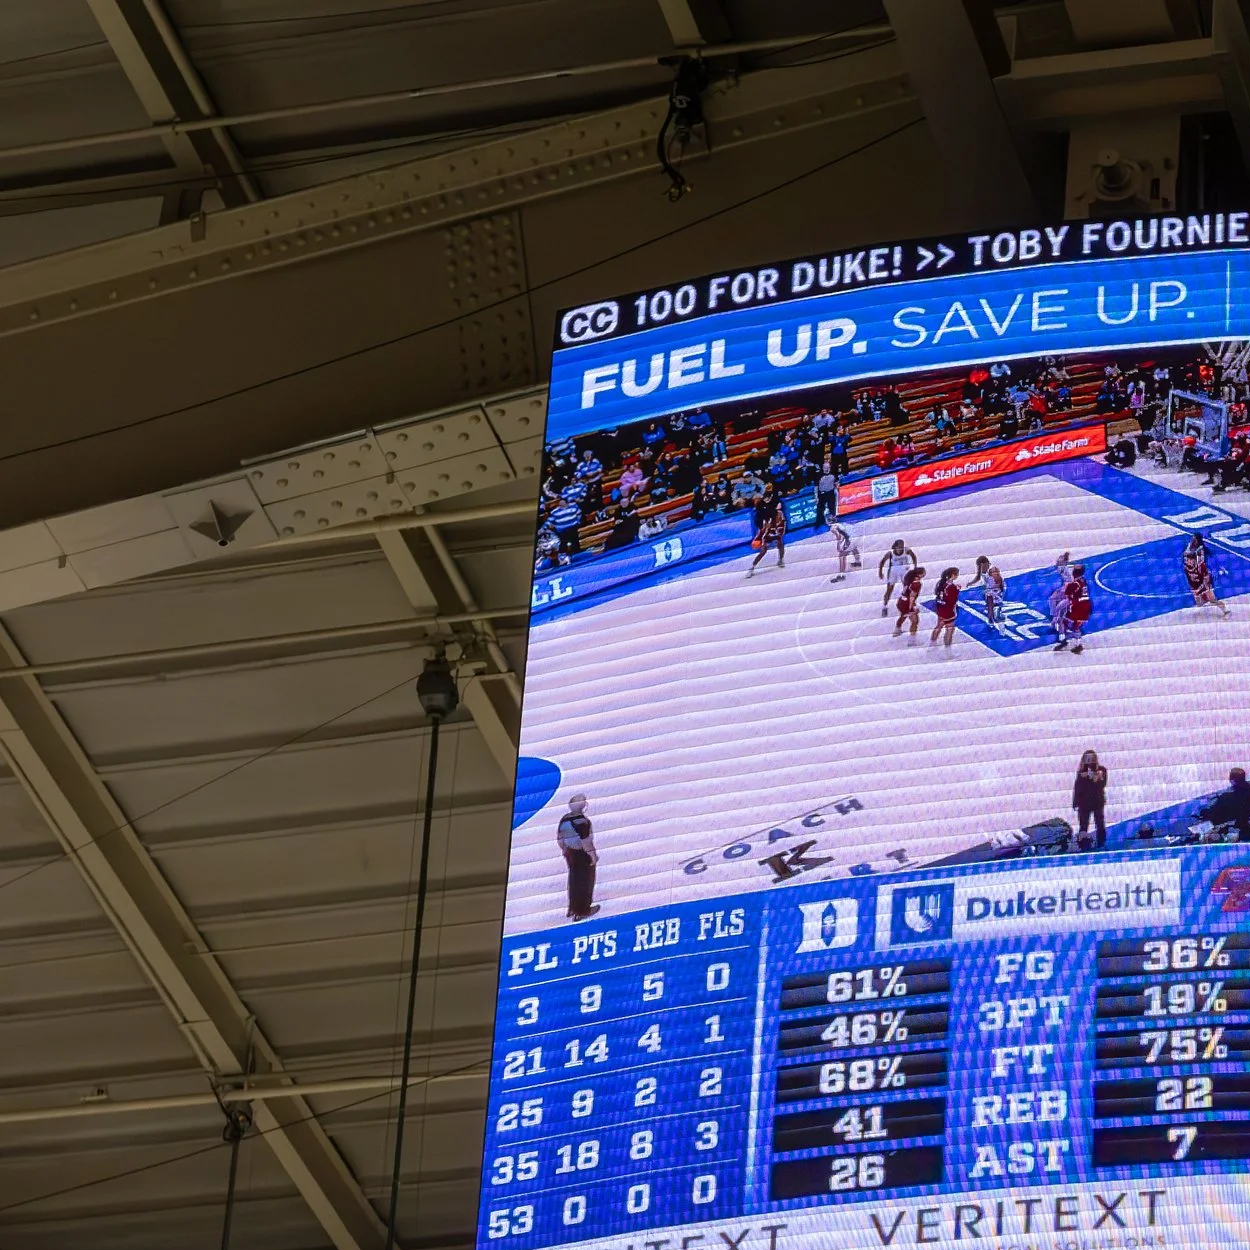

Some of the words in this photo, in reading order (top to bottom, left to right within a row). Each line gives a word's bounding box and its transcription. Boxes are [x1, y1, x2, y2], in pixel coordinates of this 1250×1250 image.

[634, 285, 697, 325] 100
[707, 269, 779, 308] FOR
[791, 247, 902, 292] DUKE!
[968, 226, 1069, 266] TOBY
[581, 339, 745, 409] FUEL
[766, 318, 867, 368] UP.
[891, 289, 1068, 348] SAVE
[1096, 280, 1195, 325] UP.
[965, 881, 1165, 921] DukeHealth
[508, 944, 557, 975] PL
[572, 930, 616, 963] PTS
[634, 918, 680, 951] REB
[698, 908, 744, 940] FLS
[826, 966, 907, 1004] 61%
[995, 951, 1054, 984] FG
[1142, 936, 1231, 972] 36%
[517, 998, 539, 1025] 3
[581, 985, 602, 1013] 9
[643, 973, 664, 1001] 5
[706, 963, 730, 990] 0
[821, 1009, 908, 1047] 46%
[978, 995, 1071, 1032] 3PT
[1142, 979, 1227, 1017] 19%
[503, 1051, 546, 1080] 21
[564, 1034, 609, 1068] 14
[638, 1024, 662, 1053] 4
[704, 1015, 724, 1043] 1
[818, 1057, 906, 1094] 68%
[990, 1045, 1054, 1078] FT
[1139, 1026, 1228, 1065] 75%
[496, 1098, 543, 1132] 25
[571, 1089, 594, 1118] 9
[635, 1078, 657, 1107] 2
[700, 1067, 723, 1096] 2
[833, 1106, 888, 1141] 41
[971, 1089, 1068, 1128] REB
[1156, 1075, 1215, 1111] 22
[491, 1152, 539, 1186] 35
[556, 1140, 600, 1175] 18
[630, 1130, 653, 1160] 8
[696, 1121, 718, 1151] 3
[829, 1156, 885, 1190] 26
[968, 1140, 1070, 1180] AST
[1167, 1127, 1198, 1161] 7
[488, 1205, 533, 1239] 53
[563, 1196, 587, 1225] 0
[627, 1185, 650, 1214] 0
[693, 1174, 717, 1203] 0
[870, 1190, 1166, 1246] VERITEXT
